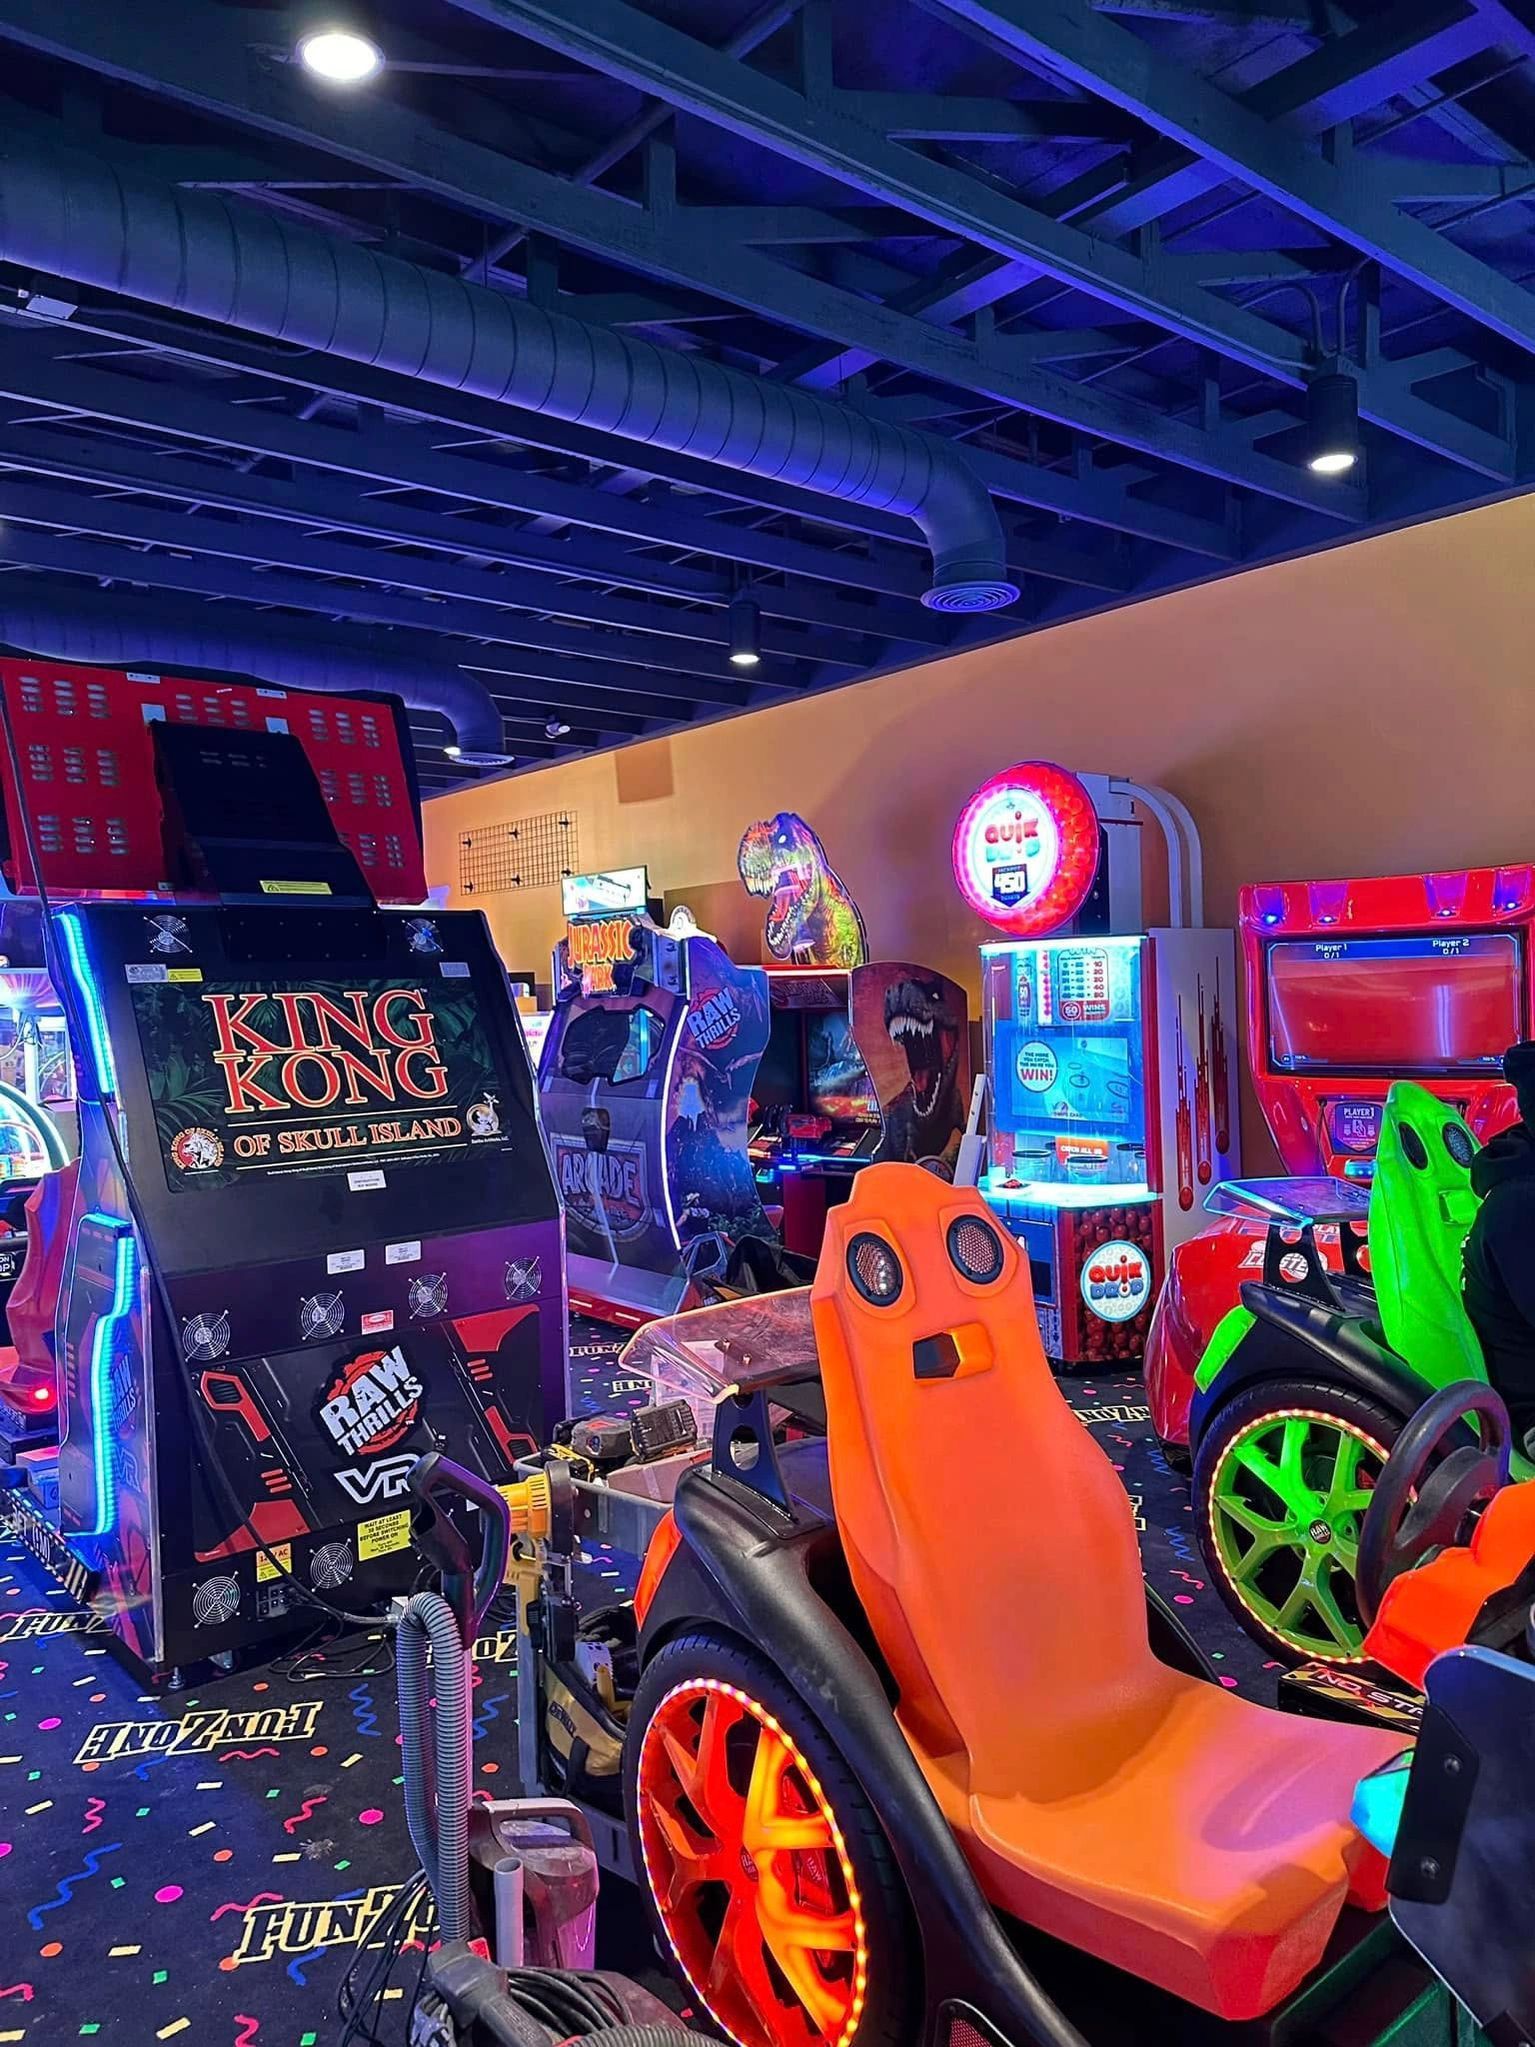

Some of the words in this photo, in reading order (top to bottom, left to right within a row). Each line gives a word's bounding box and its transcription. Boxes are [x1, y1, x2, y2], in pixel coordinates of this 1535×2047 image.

[567, 919, 635, 969] JURASSIC
[1315, 944, 1342, 952] Player
[1432, 939, 1460, 948] Player
[1462, 938, 1469, 947] 2
[201, 988, 435, 1057] KING
[686, 986, 734, 1037] RAW
[695, 1007, 741, 1049] THRILLS
[213, 1045, 449, 1114] KONG
[1020, 1069, 1053, 1081] WIN!
[1344, 1107, 1371, 1117] PLAYER
[234, 1133, 272, 1157] OF
[277, 1123, 368, 1154] SKULL
[367, 1116, 463, 1145] ISLAND
[561, 1151, 641, 1207] ARCADE
[1090, 1278, 1145, 1301] DROP
[319, 1345, 411, 1440] RAW
[337, 1375, 424, 1456] THRILLS
[333, 1453, 421, 1504] VR
[364, 1520, 378, 1529] WAIT
[386, 1514, 402, 1523] LEAST
[278, 1548, 288, 1557] AC
